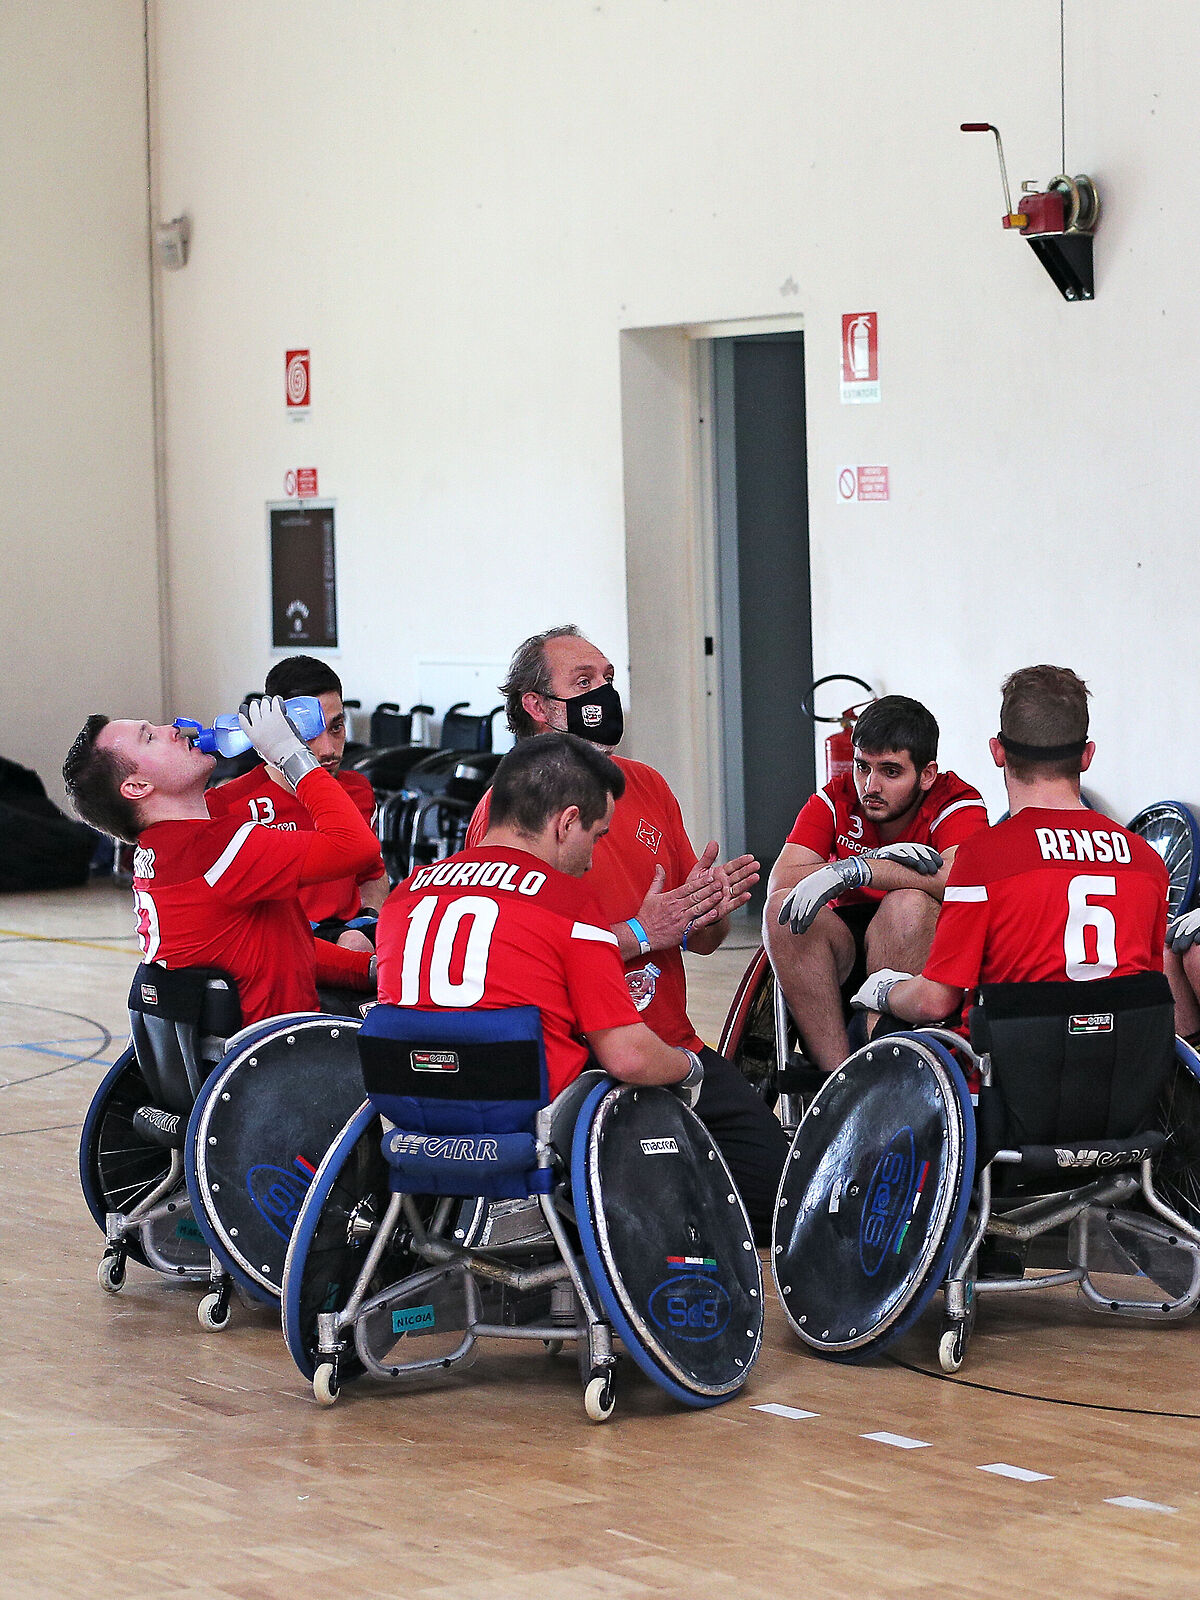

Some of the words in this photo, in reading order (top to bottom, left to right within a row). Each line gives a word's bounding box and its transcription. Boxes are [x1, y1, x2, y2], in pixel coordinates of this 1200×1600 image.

[248, 797, 275, 823] 13
[847, 815, 864, 838] 3
[837, 834, 873, 853] macr
[1035, 828, 1132, 864] RENSO
[409, 862, 548, 896] GIURIOLO
[1064, 875, 1118, 981] 6
[397, 896, 500, 1007] 10
[641, 1138, 679, 1151] macron
[397, 1312, 432, 1327] NICOLA
